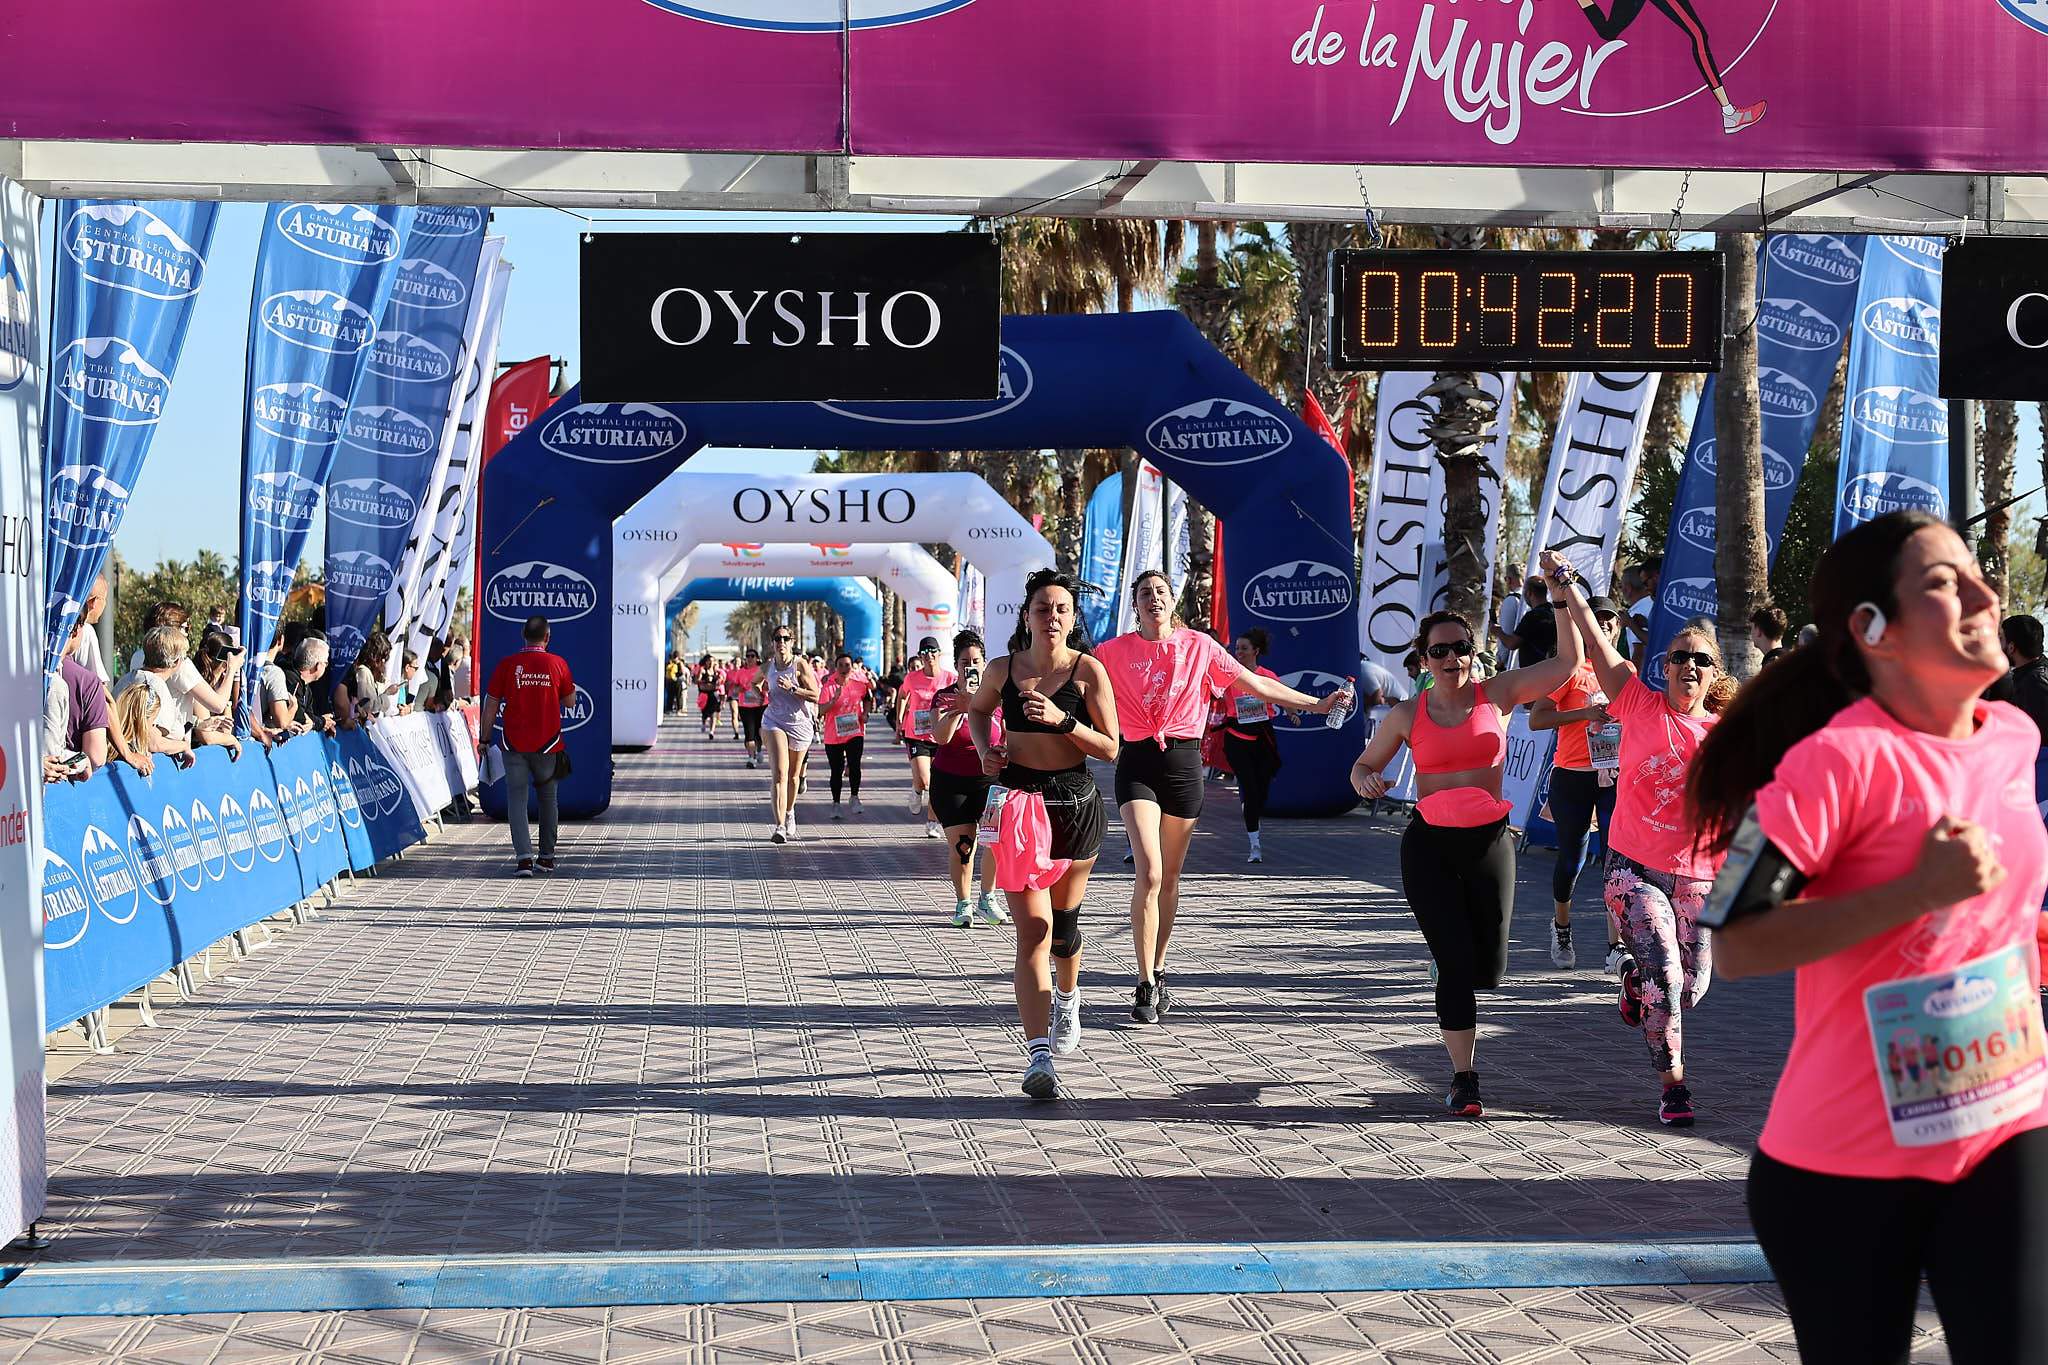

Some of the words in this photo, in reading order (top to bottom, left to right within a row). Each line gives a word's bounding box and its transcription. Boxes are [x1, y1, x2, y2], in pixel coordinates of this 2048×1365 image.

[1291, 4, 1346, 66] de
[1359, 4, 1398, 67] la
[1390, 0, 1628, 145] Mujer
[286, 211, 391, 256] ASTURIANA
[1773, 238, 1855, 280] ASTURIANA
[393, 278, 457, 302] TURIANA
[650, 286, 942, 349] OYSHO
[1360, 270, 1694, 350] 00:42:20
[1757, 315, 1831, 345] STURIANA
[368, 349, 443, 376] STURIANA
[254, 395, 341, 434] ASTURIAN
[573, 418, 620, 426] CENTRAL
[624, 420, 673, 428] LECHERA
[1177, 421, 1228, 430] CENTRAL
[1230, 420, 1276, 428] LECHERA
[549, 421, 675, 447] ASTURIANA
[1159, 425, 1284, 450] ASTURIANA
[329, 488, 410, 521] ASTURIANA
[733, 488, 917, 525] OYSHO
[622, 529, 678, 542] OYSHO
[968, 527, 1023, 540] OYSHO
[1368, 399, 1435, 655] OYSHO
[490, 584, 589, 609] ASTURIANA
[503, 582, 542, 590] CENTRAL
[1250, 584, 1348, 608] ASTURIANA
[44, 884, 87, 922] URIANA
[1942, 1031, 2006, 1072] 016
